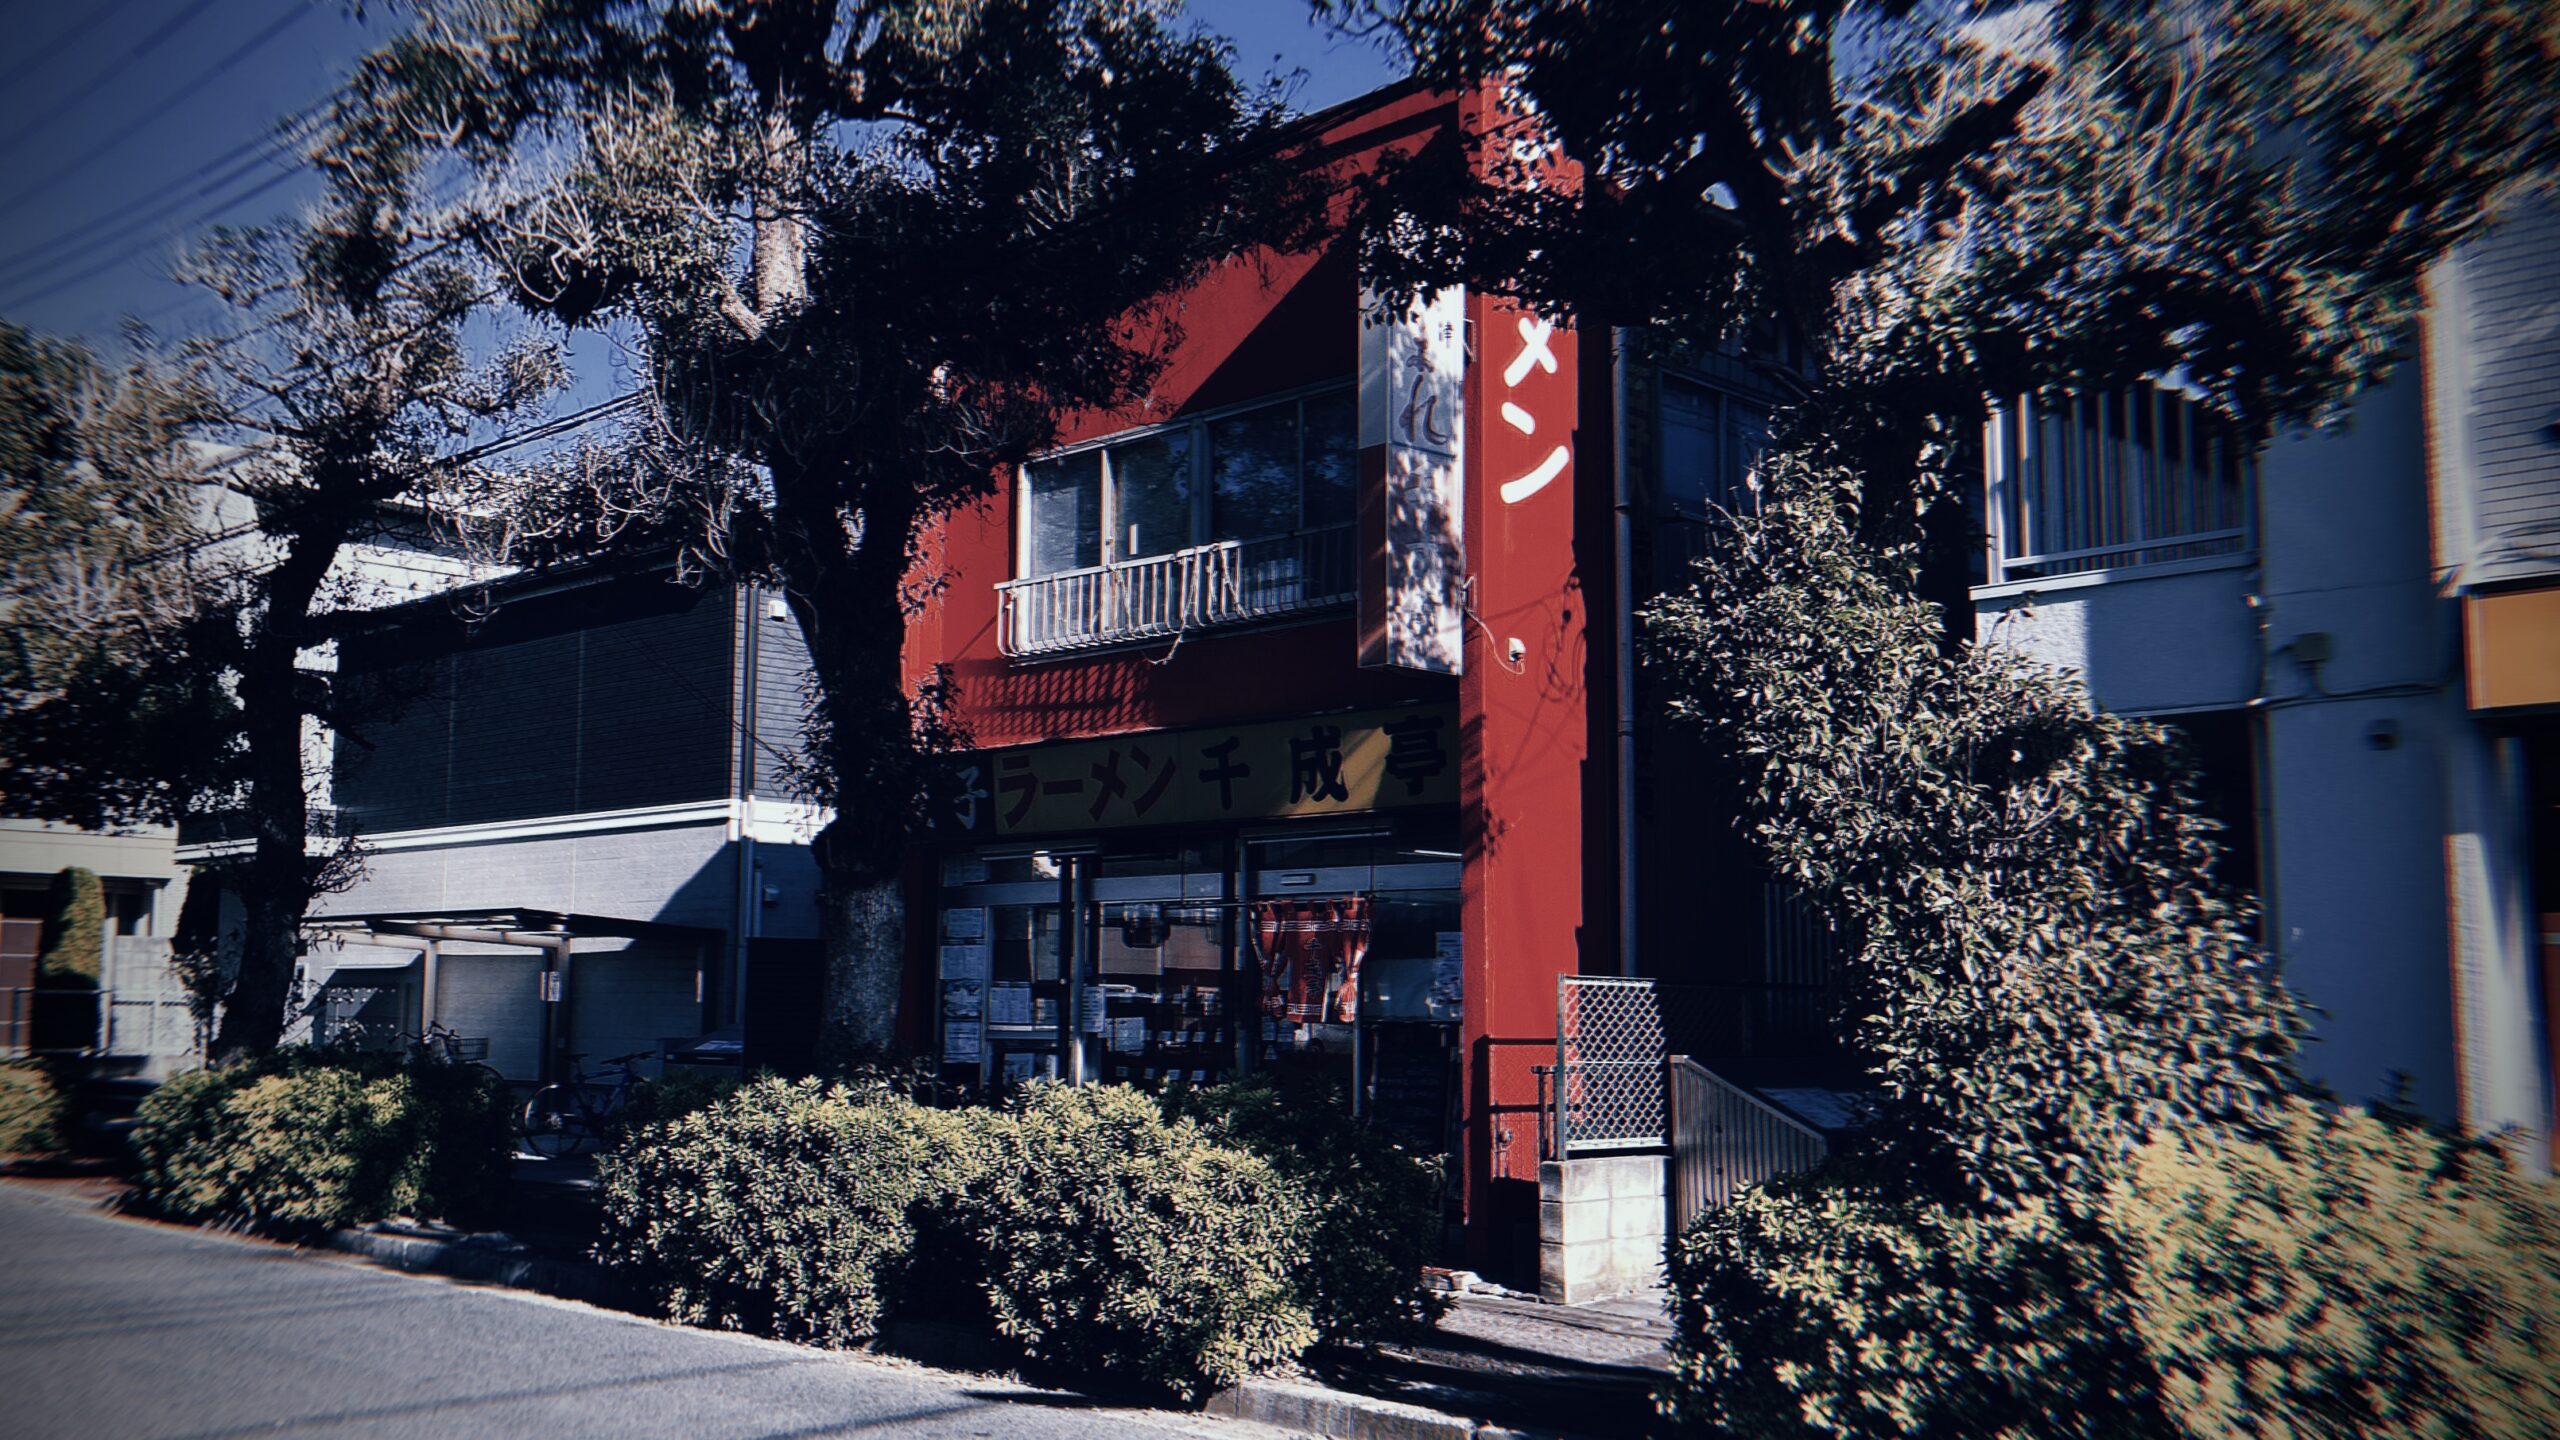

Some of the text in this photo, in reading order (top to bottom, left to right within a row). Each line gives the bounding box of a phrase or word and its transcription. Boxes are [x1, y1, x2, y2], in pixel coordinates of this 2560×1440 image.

[999, 715, 1446, 829] ラーメン 千成亭
